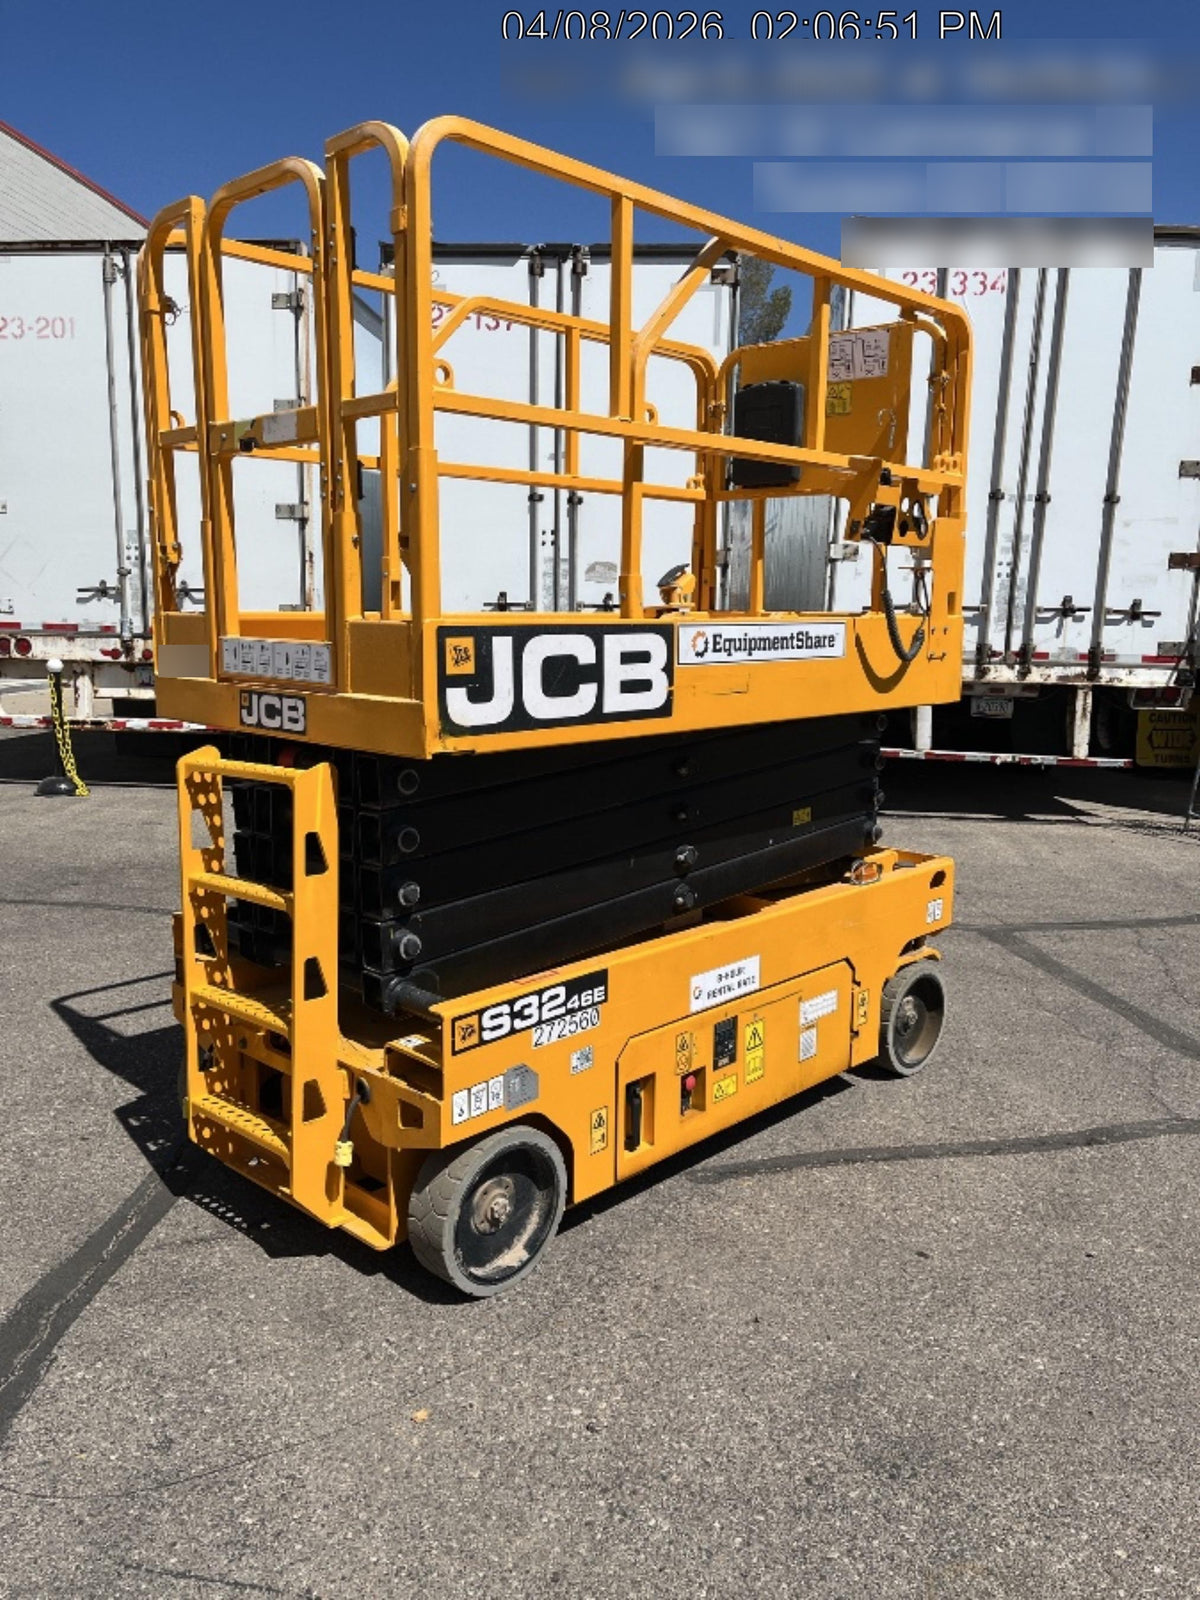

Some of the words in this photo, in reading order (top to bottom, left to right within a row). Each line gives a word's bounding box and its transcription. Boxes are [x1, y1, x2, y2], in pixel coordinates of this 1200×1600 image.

[0, 316, 75, 339] 23-201
[712, 631, 836, 656] EquipmentShare
[446, 633, 669, 727] JCB
[241, 694, 305, 732] JCB
[533, 1006, 600, 1048] 272560
